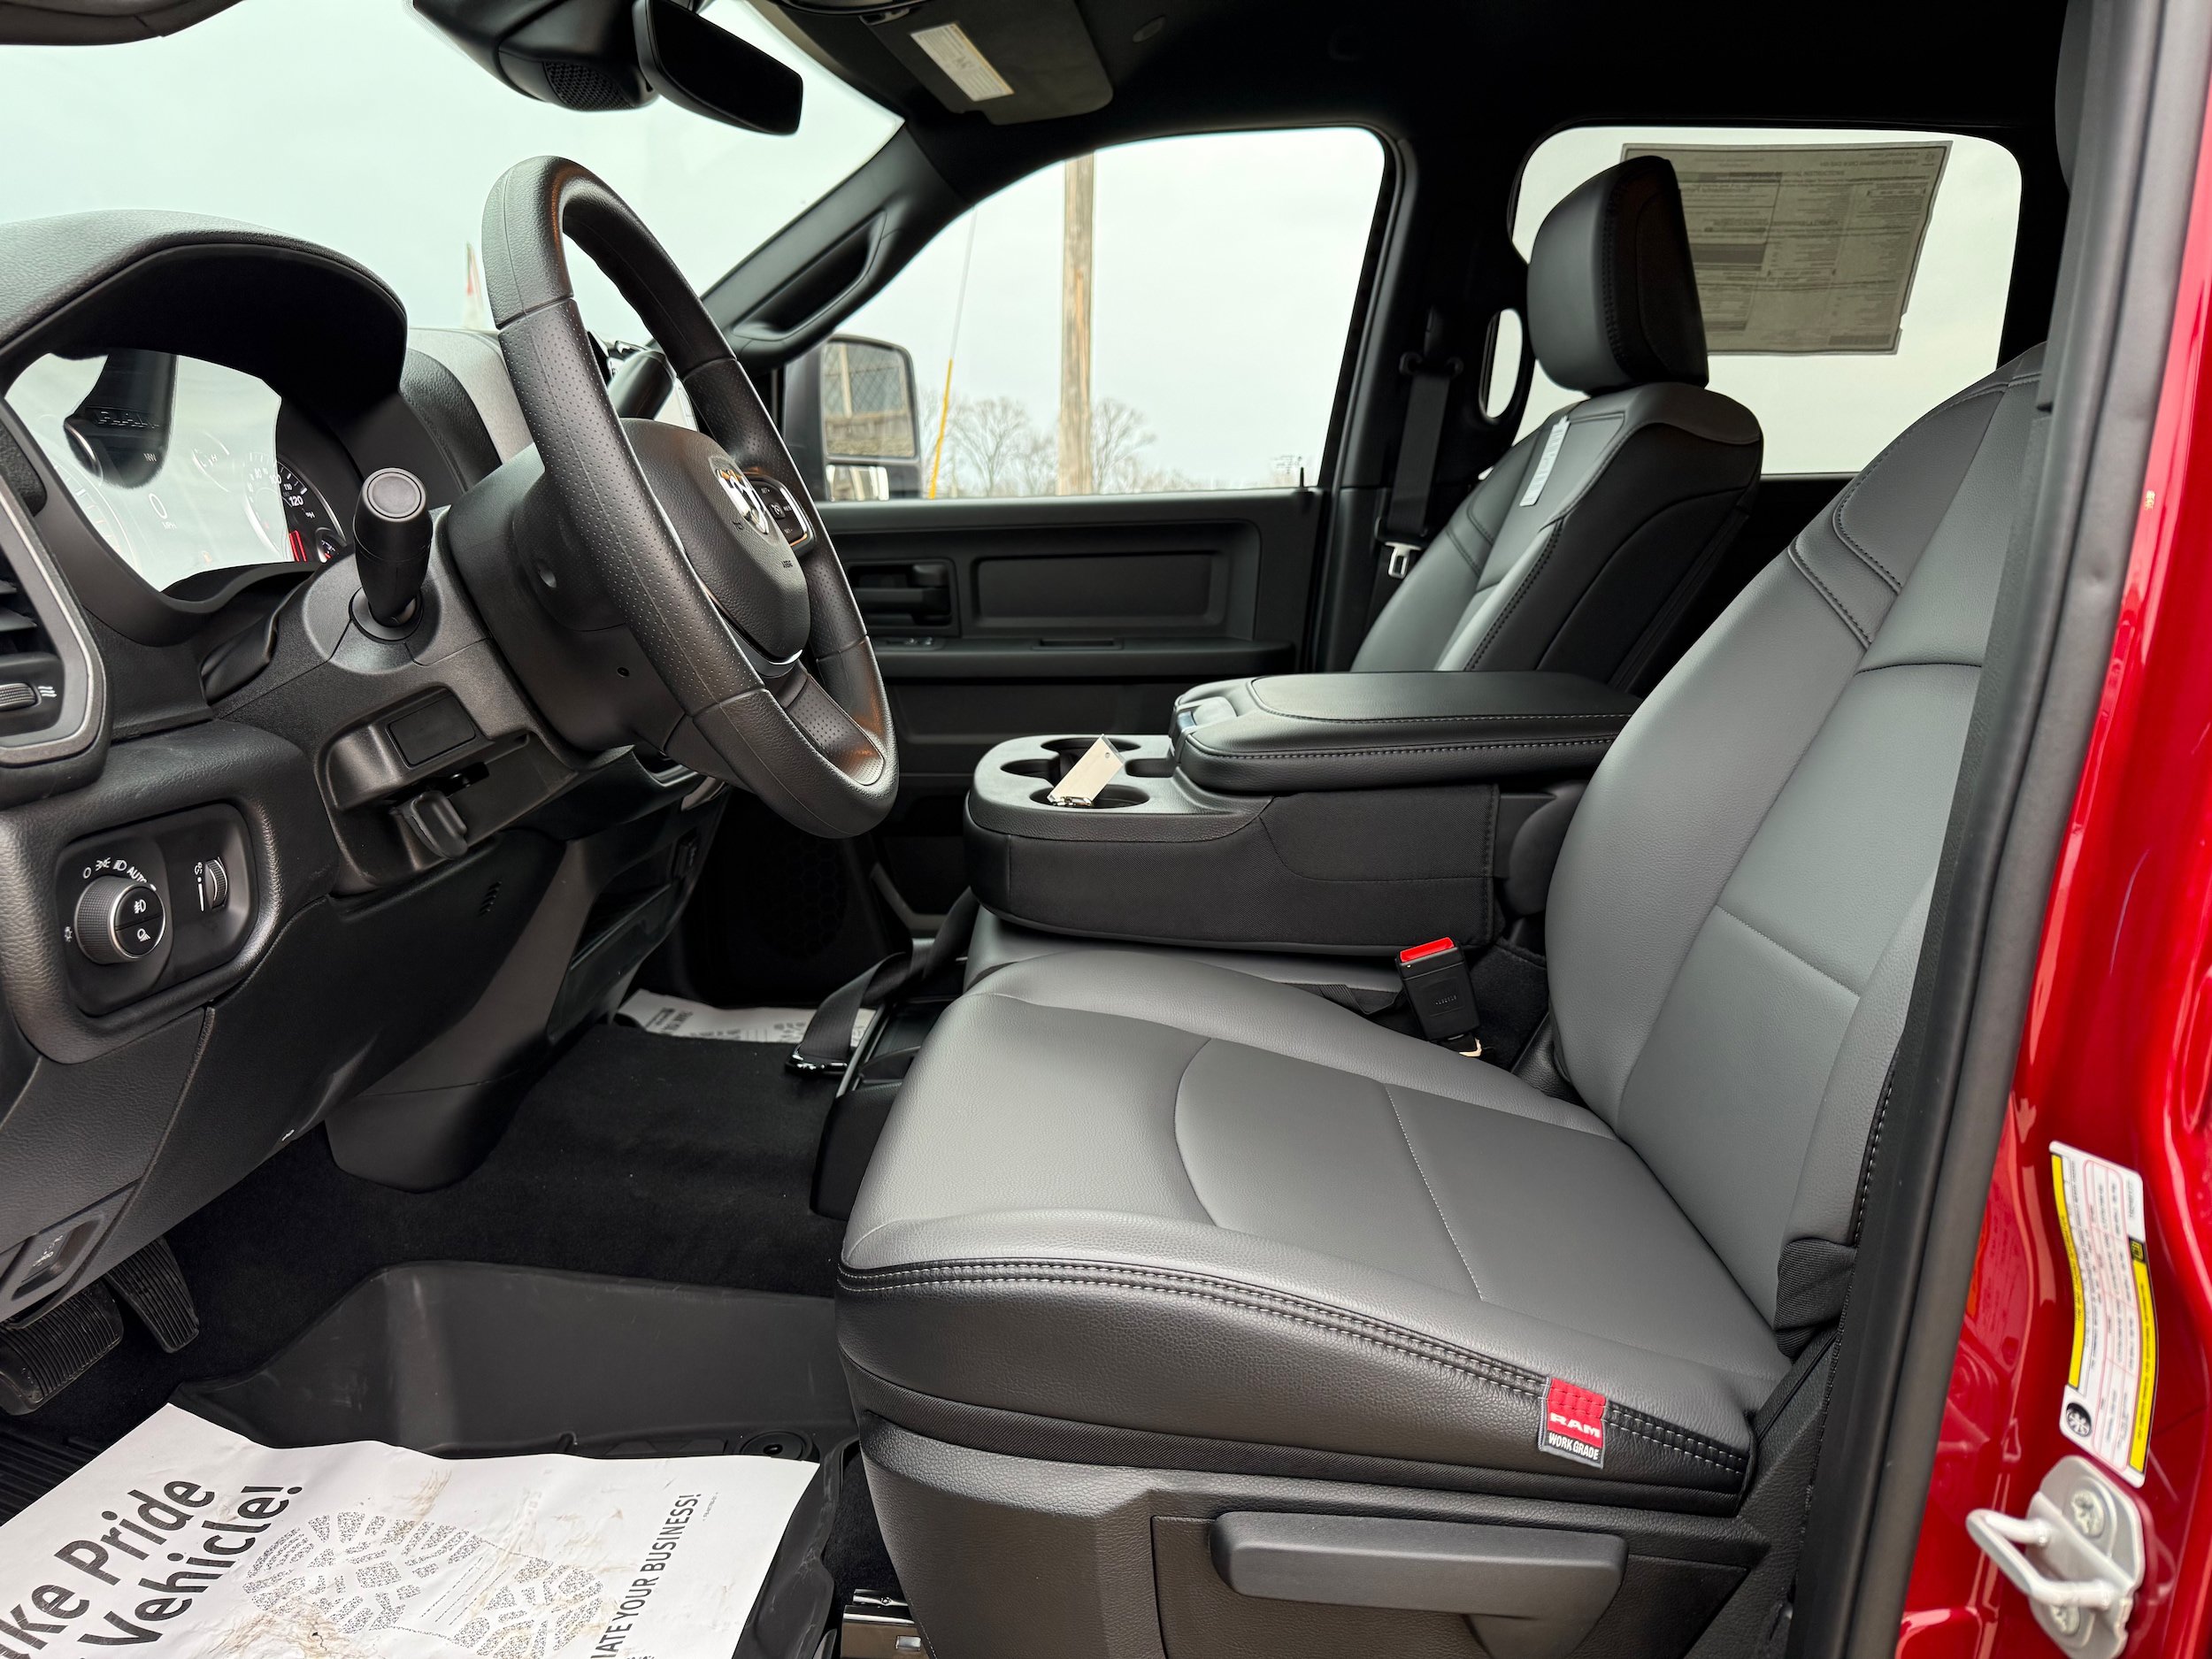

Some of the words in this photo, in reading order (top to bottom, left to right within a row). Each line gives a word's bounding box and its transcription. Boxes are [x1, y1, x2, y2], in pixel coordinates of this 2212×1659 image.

[269, 473, 281, 485] 100
[288, 495, 303, 507] 120
[127, 866, 149, 883] AUTO
[1549, 1412, 1601, 1439] RAM
[1548, 1432, 1572, 1451] WORK
[1572, 1441, 1600, 1461] GRADE
[54, 1479, 215, 1586] Pride
[78, 1485, 303, 1647] Vehicle!
[612, 1576, 660, 1622] YOUR
[640, 1494, 702, 1572] BUSINESS!
